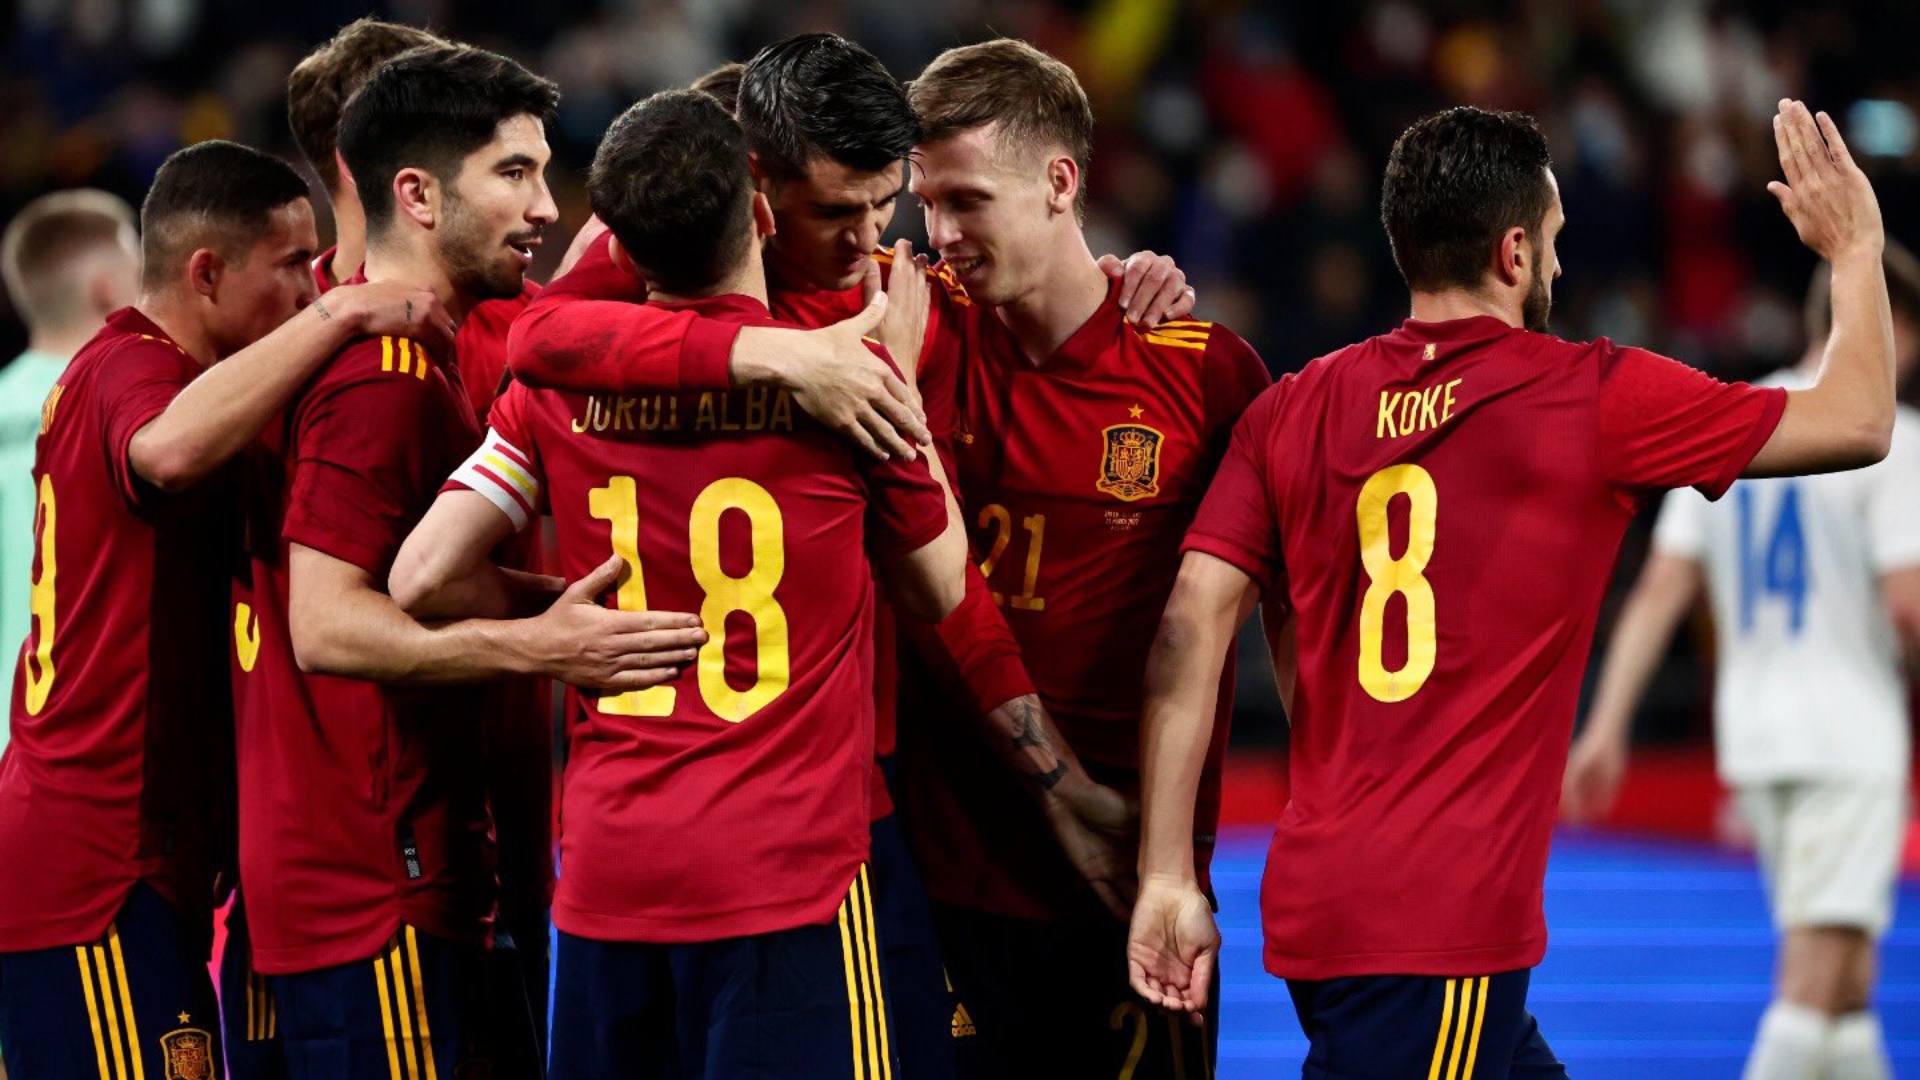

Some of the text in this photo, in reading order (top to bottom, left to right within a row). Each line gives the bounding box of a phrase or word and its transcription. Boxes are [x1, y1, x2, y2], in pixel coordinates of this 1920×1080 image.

[571, 386, 793, 433] JORDI ALBA
[1376, 378, 1463, 438] KOKE
[588, 476, 790, 723] 18
[978, 503, 1046, 611] 21
[1356, 463, 1437, 703] 8
[1735, 482, 1811, 633] 14
